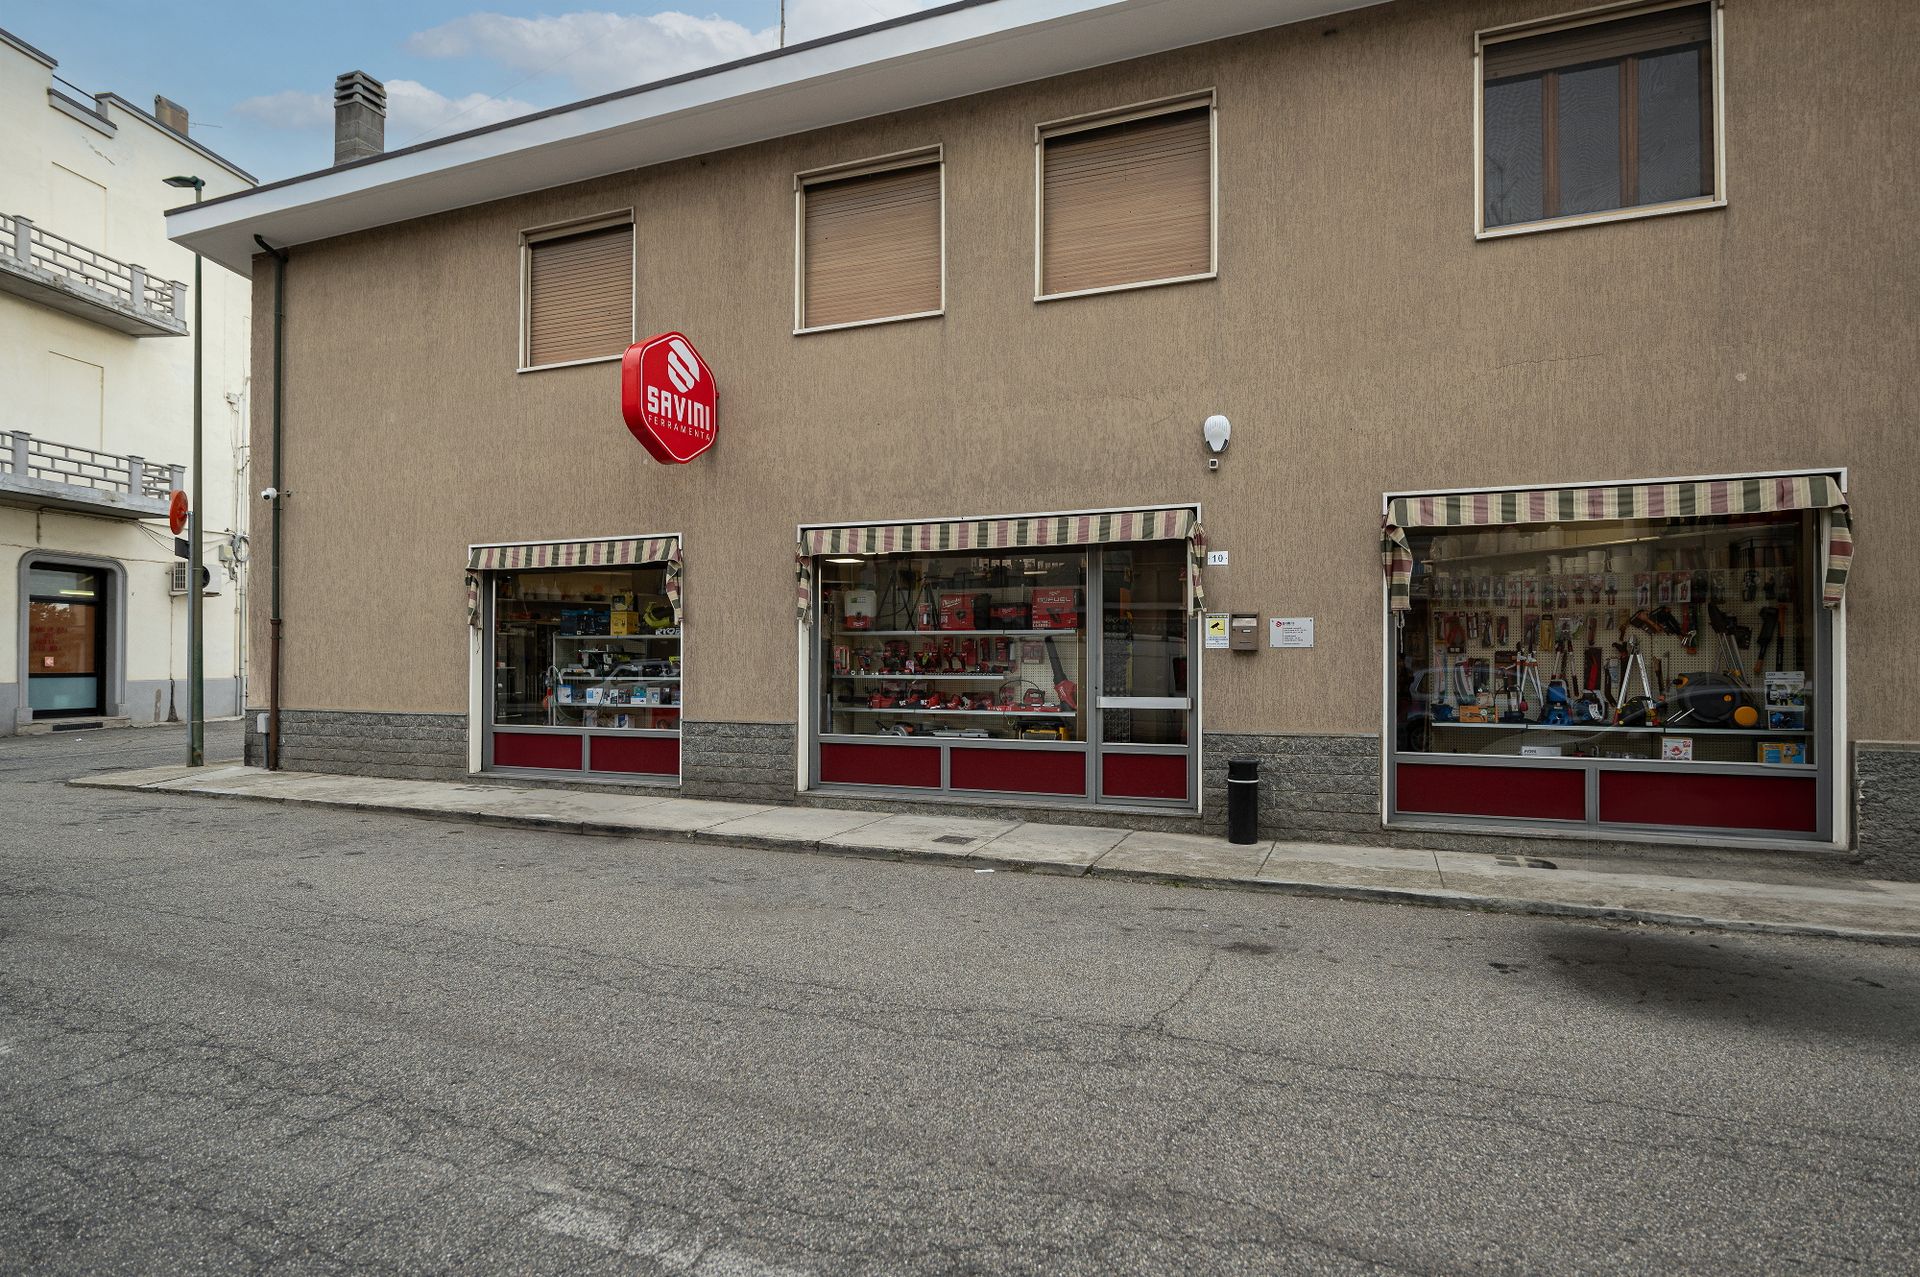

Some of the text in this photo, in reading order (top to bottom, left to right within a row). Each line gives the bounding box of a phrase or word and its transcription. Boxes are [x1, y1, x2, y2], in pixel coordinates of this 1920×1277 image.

[647, 385, 710, 431] SAVINI
[648, 414, 711, 442] FERRAMENTA
[1212, 554, 1224, 562] 10
